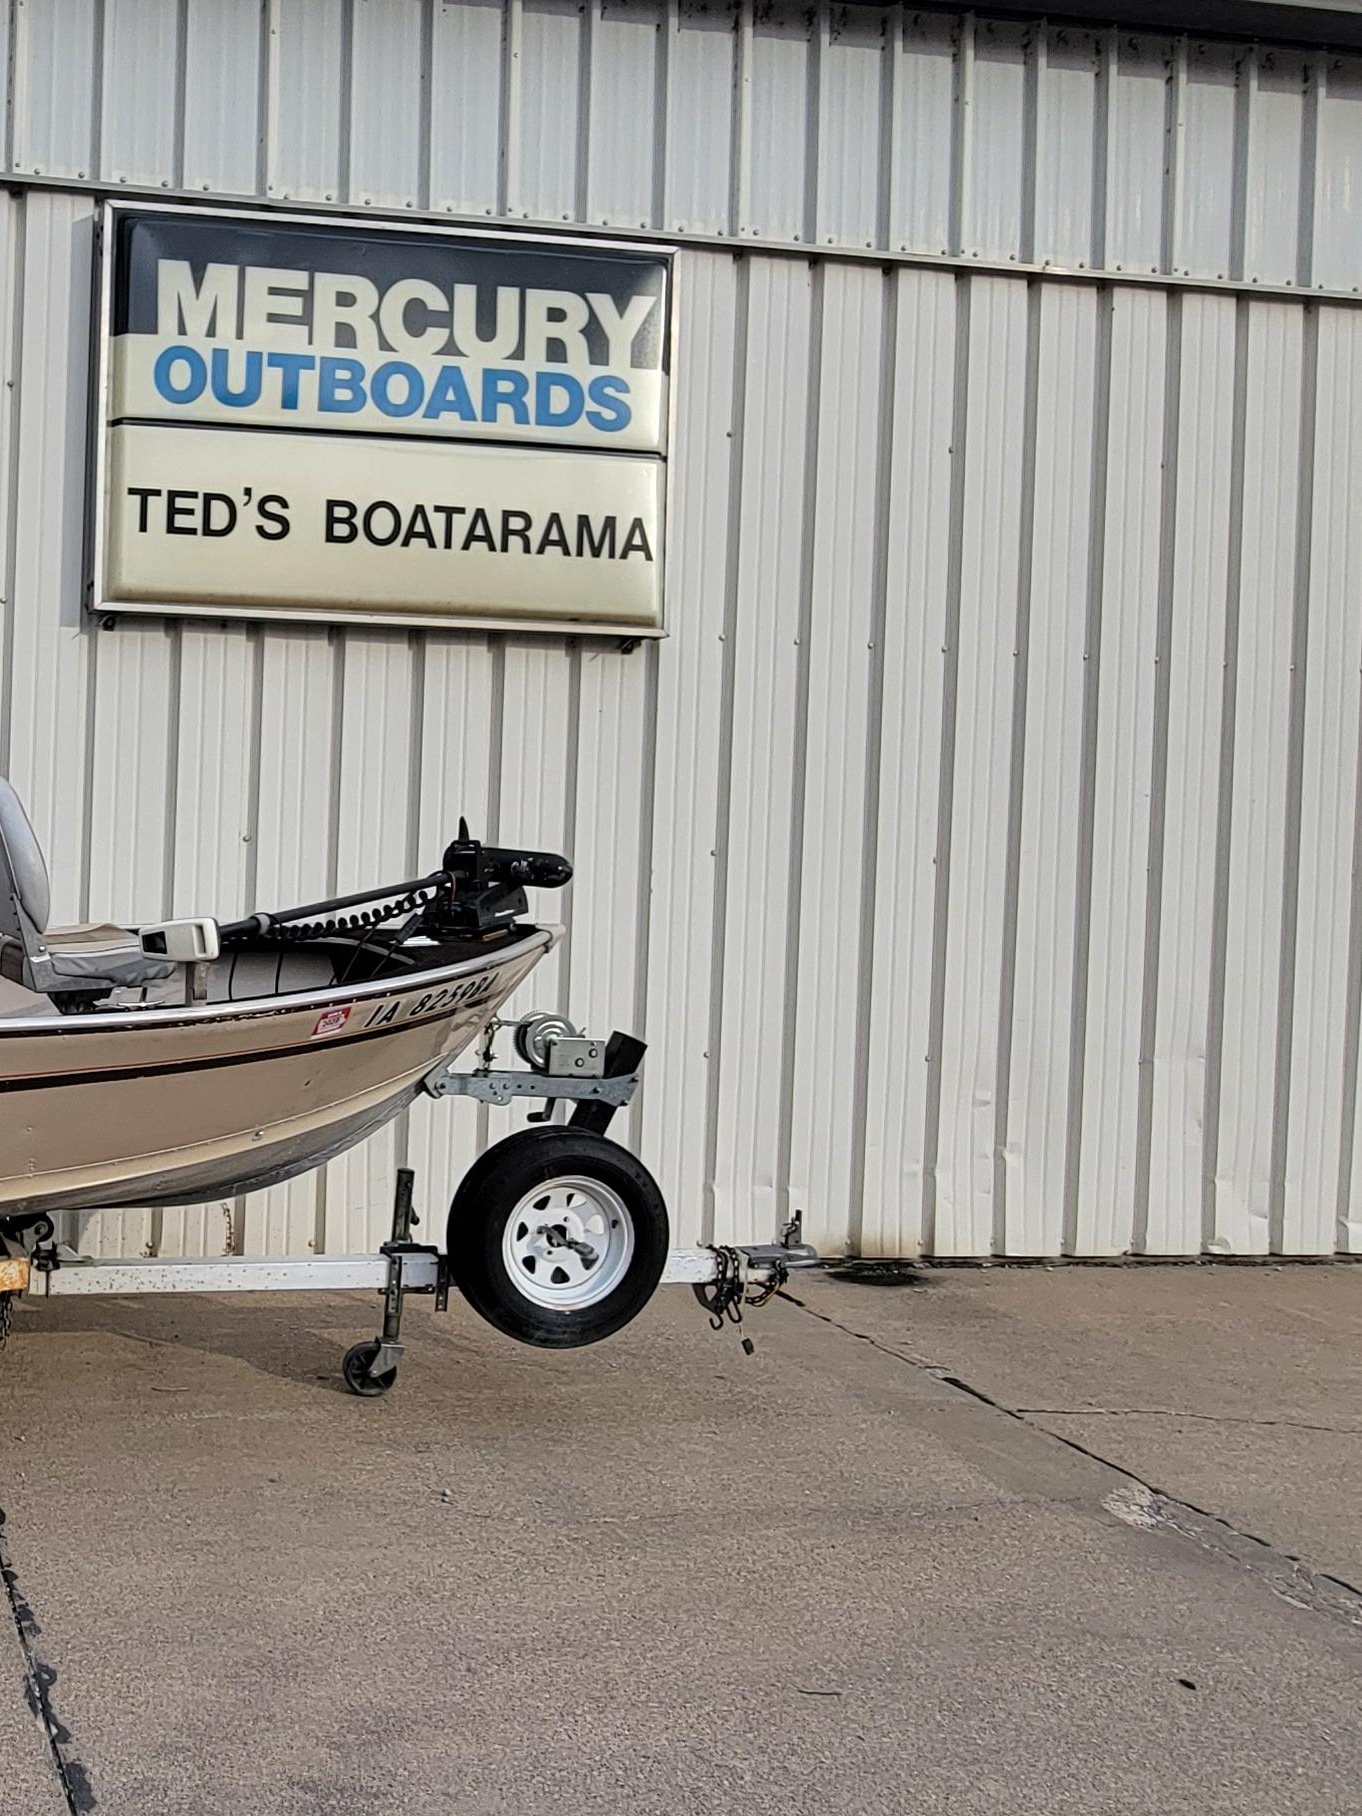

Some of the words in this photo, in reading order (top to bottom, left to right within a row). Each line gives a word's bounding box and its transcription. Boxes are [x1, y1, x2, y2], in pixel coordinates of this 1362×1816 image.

[156, 258, 658, 369] MERCURY
[153, 345, 633, 433] OUTBOARDS
[127, 486, 292, 541] TED'S
[324, 498, 655, 562] BOATARAMA
[364, 1001, 402, 1028] IA
